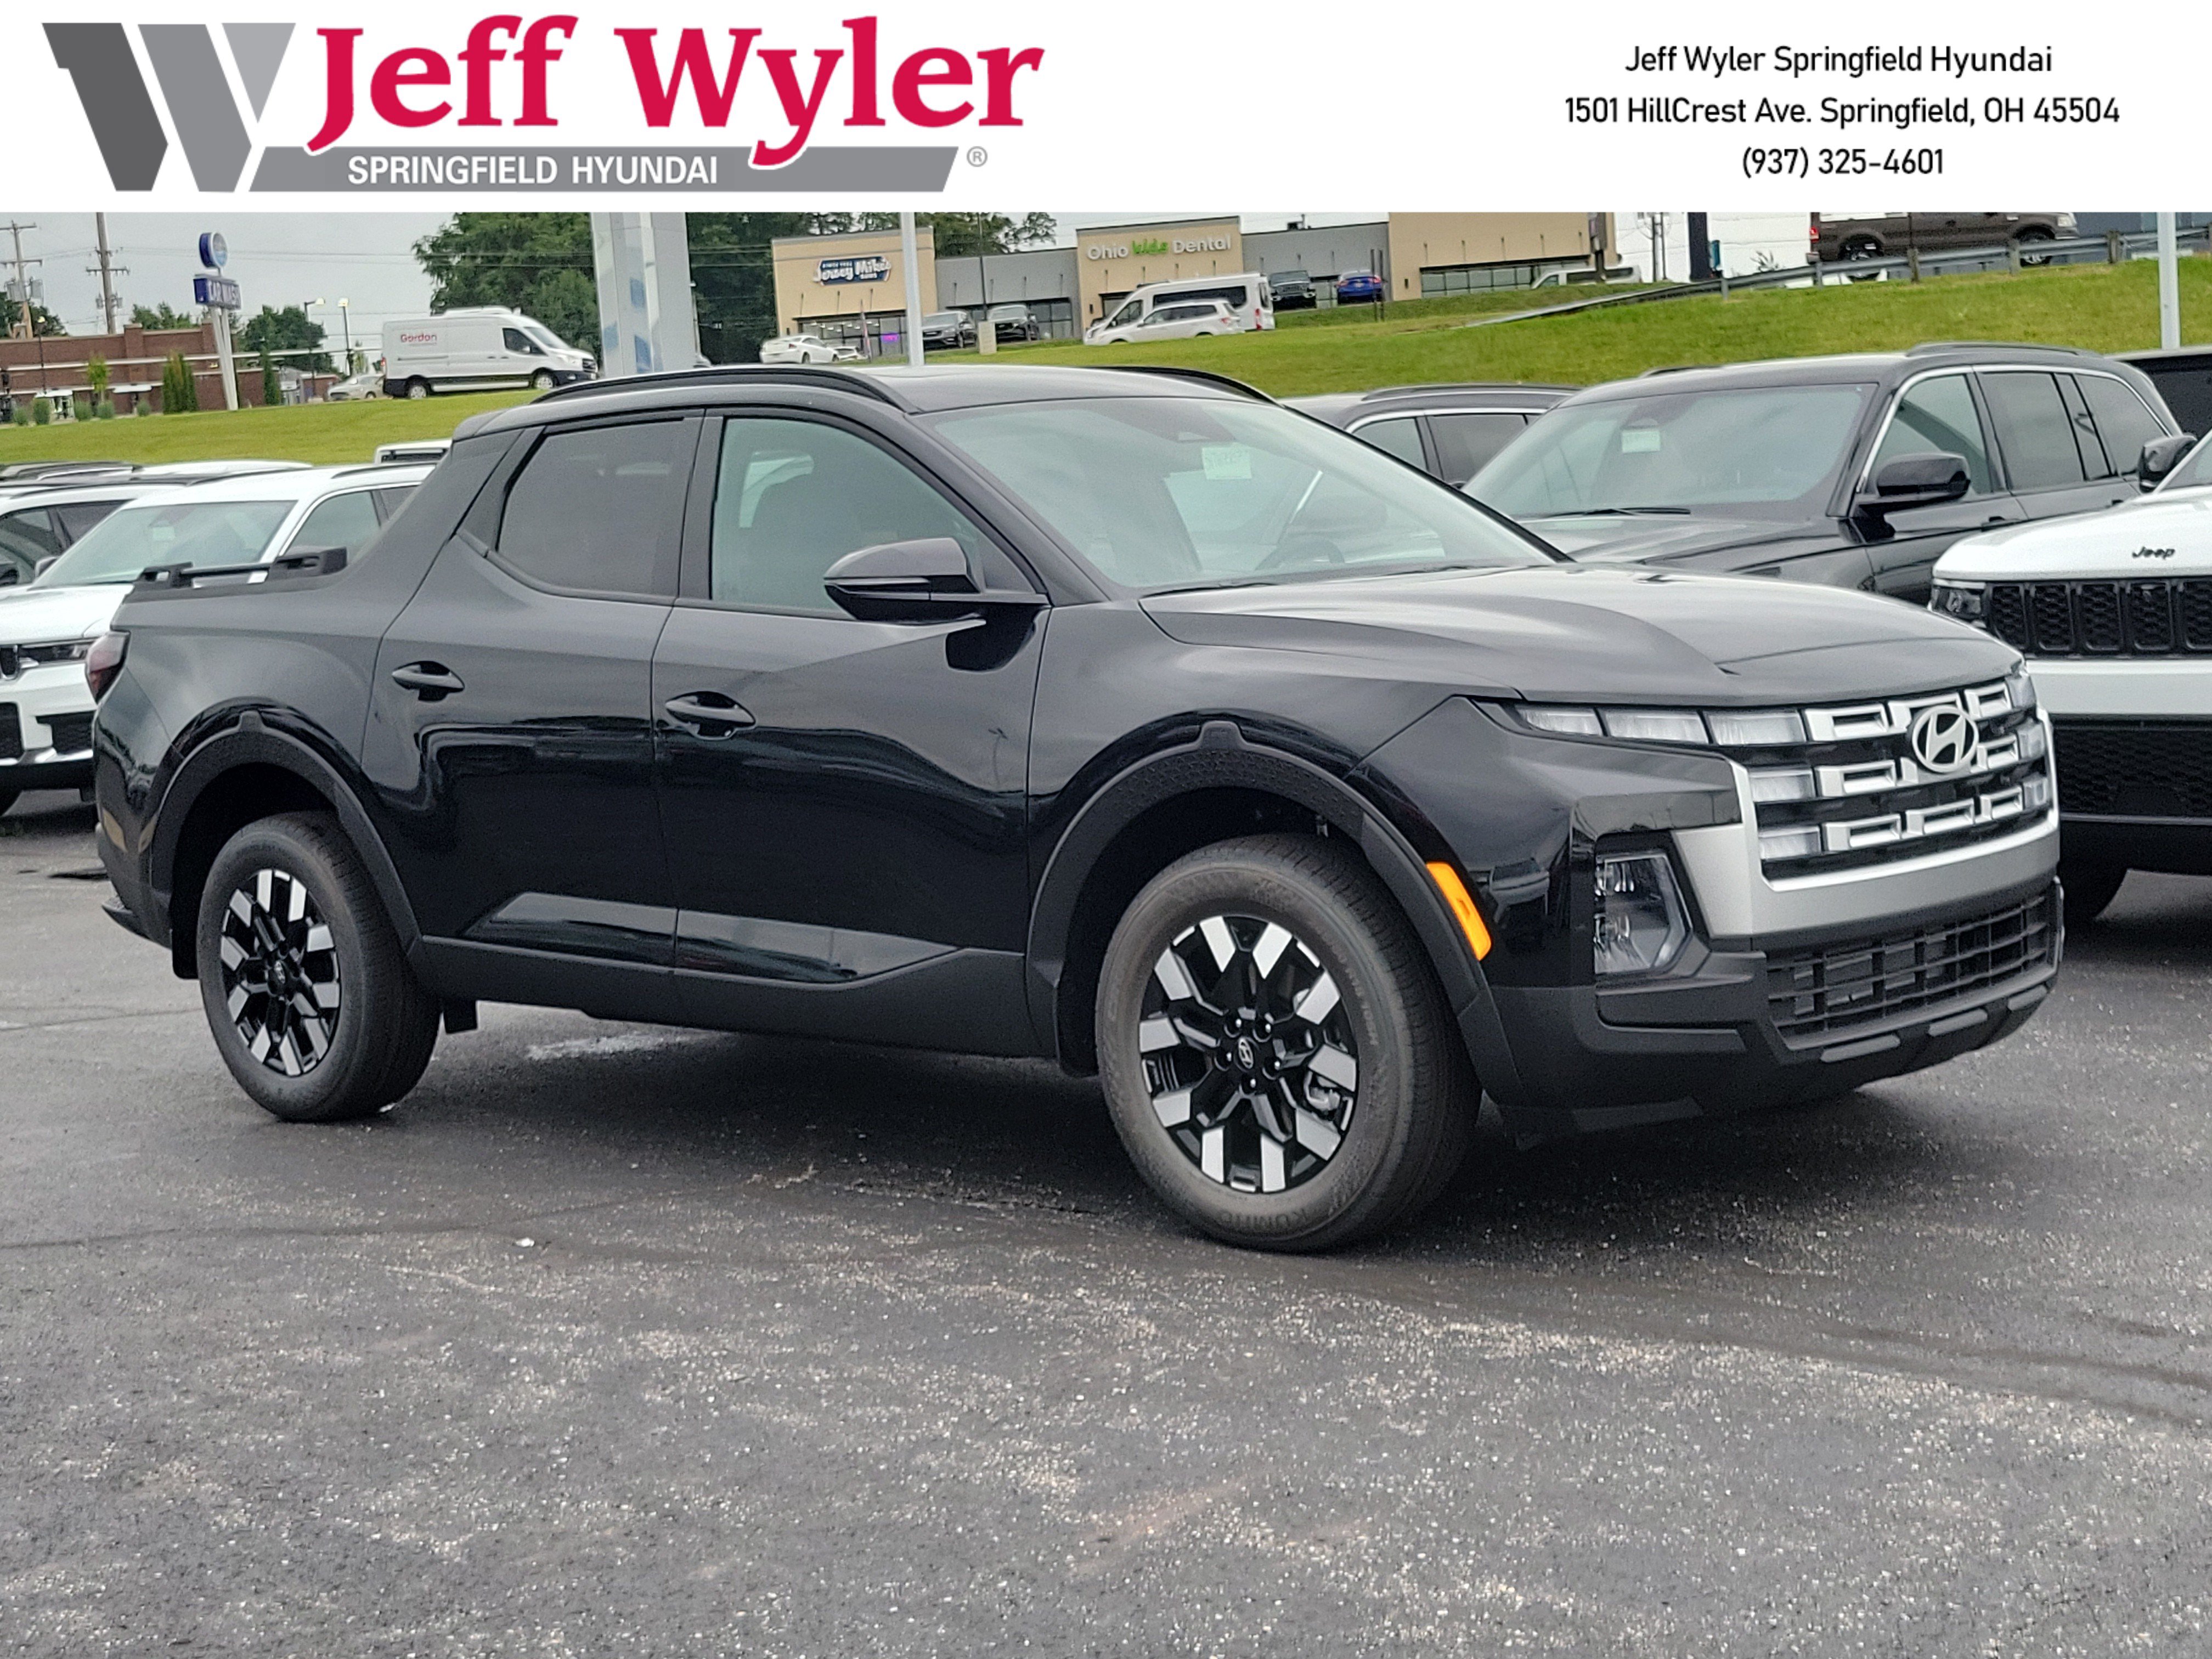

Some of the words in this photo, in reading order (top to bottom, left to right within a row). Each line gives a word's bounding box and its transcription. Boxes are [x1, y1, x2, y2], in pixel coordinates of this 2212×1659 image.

[1087, 243, 1128, 260] Ohio
[1172, 234, 1231, 254] Dental
[400, 333, 437, 343] Gordon
[2131, 546, 2175, 560] Jeep
